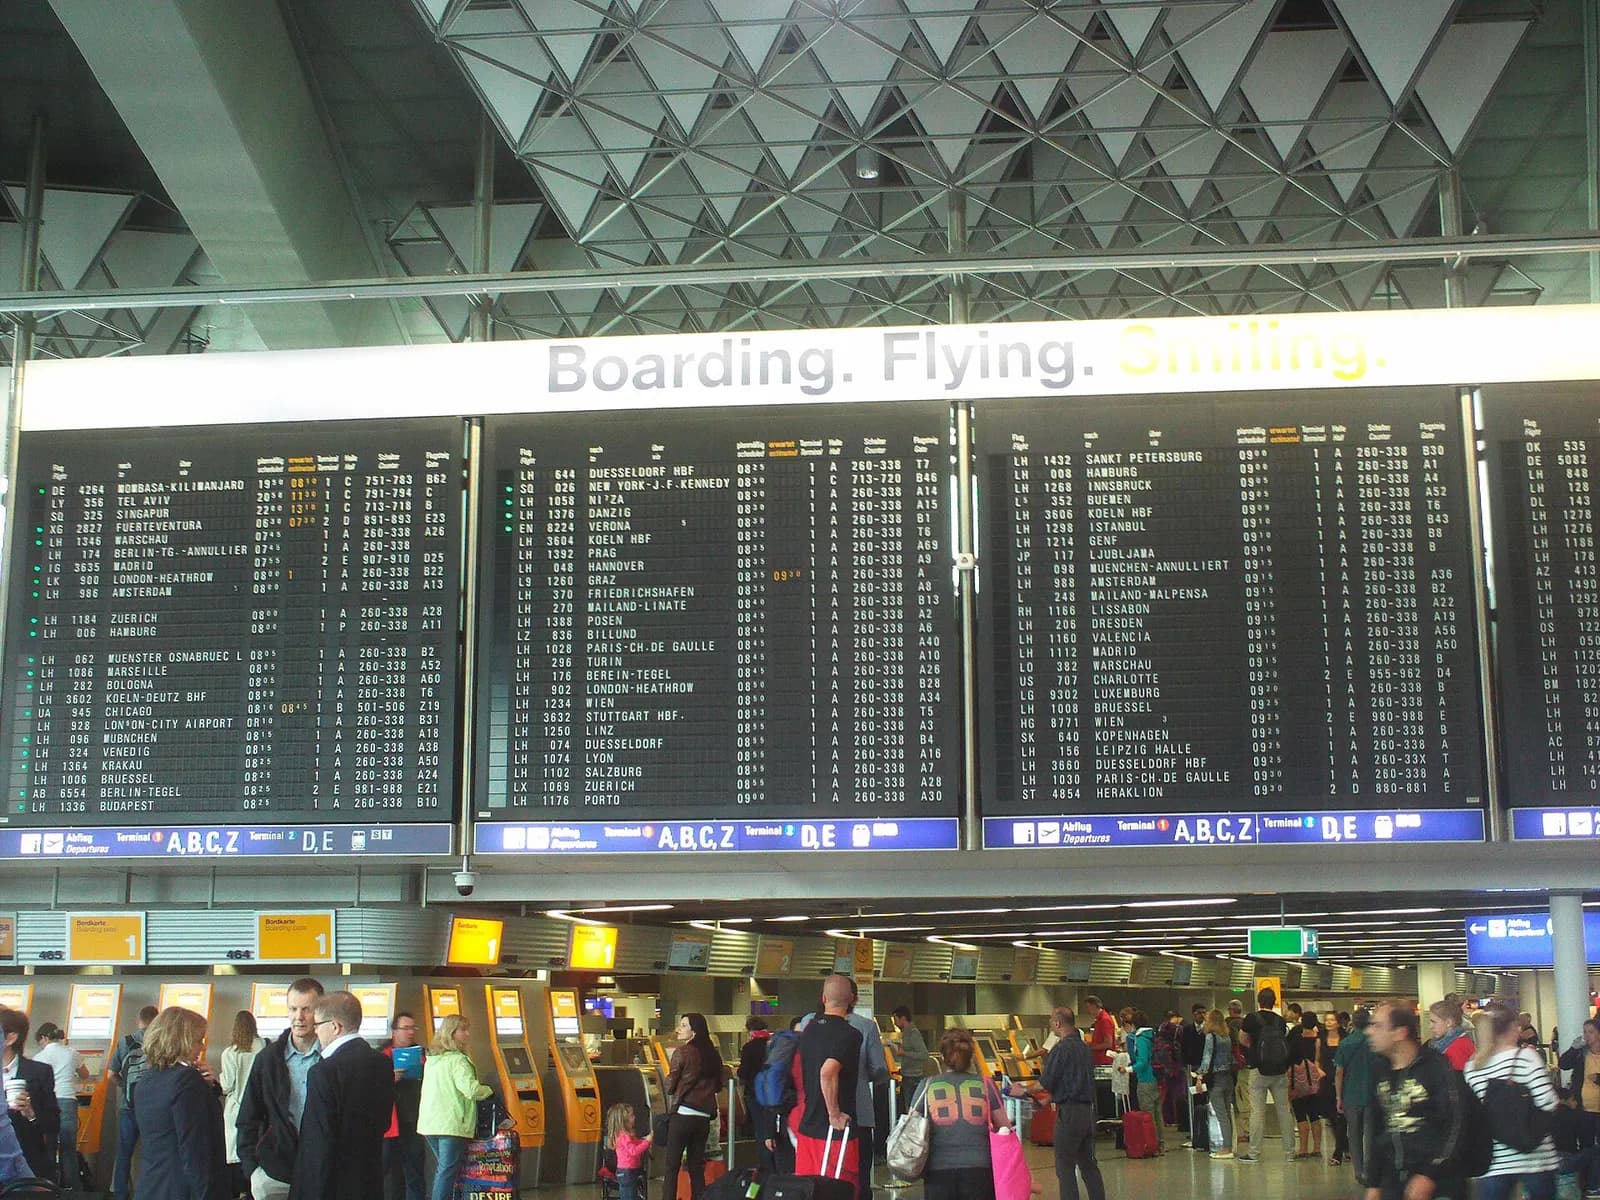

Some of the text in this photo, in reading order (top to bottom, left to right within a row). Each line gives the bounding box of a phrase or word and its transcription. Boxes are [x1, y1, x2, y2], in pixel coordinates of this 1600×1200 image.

[548, 320, 1386, 395] Boarding. Flying. Smiling.
[1526, 441, 1585, 452] OK 535
[1086, 452, 1202, 464] SANKT PETERSBURG
[1527, 456, 1541, 466] DE
[590, 466, 693, 478] DUESSELDORF HBF
[1087, 467, 1137, 477] HAMBURG
[1567, 468, 1588, 478] 848
[853, 474, 901, 484] 713-720
[589, 482, 610, 491] NEW
[1089, 480, 1151, 491] INNSBRUCK
[1530, 482, 1589, 493] LH 128
[366, 488, 411, 498] 791-794
[118, 496, 170, 506] TEL AVIV
[1570, 496, 1590, 505] 143
[117, 509, 169, 519] SINGAPUR
[589, 508, 630, 518] DANZIG
[1088, 507, 1152, 518] KOELN HBF
[1564, 509, 1591, 520] 1278
[116, 521, 201, 532] FUERTEVENTURA
[589, 521, 630, 531] VERONA
[1090, 521, 1145, 532] ISTANBUL
[1565, 523, 1592, 533] 1276
[115, 535, 168, 544] WARSCHAU
[589, 534, 651, 544] KOELN HBF
[1090, 536, 1117, 546] GENF
[589, 548, 616, 558] PRAG
[1575, 551, 1594, 561] 178
[114, 561, 153, 571] MADRID
[589, 561, 644, 571] HANNOVER
[1090, 560, 1228, 573] MUENCHEN-ANNULLIERT
[1536, 565, 1595, 576] AZ 413
[114, 573, 213, 584] LONDON-HEATHROW
[588, 575, 615, 585] GRAZ
[1091, 576, 1156, 587] AMSTERDAM
[1569, 579, 1596, 589] 1490
[113, 587, 171, 597] AMSTERDAM
[589, 587, 694, 598] FRIEDRICHSHAFEN
[1091, 589, 1207, 600] MAILAND-MALPENSA
[588, 600, 686, 612] MAILAND-LINATE
[1092, 604, 1149, 615] LISSABON
[111, 613, 157, 623] ZUERICH
[588, 616, 622, 625] POSEN
[1092, 618, 1142, 628] DRESDEN
[110, 626, 156, 636] HAMBURG
[588, 629, 636, 639] BILLUND
[1092, 632, 1150, 642] VALENCIA
[673, 641, 714, 651] GAULLE
[1093, 646, 1136, 656] MADRID
[108, 653, 161, 663] MUENSTER
[169, 651, 228, 662] OSNABRUEC
[588, 657, 622, 666] TURIN
[1093, 660, 1151, 670] WARSCHAU
[108, 666, 167, 676] MARSEILLE
[1370, 668, 1420, 679] 955-962
[1094, 674, 1158, 685] CHARLOTTE
[107, 680, 153, 690] BOLOGNA
[587, 683, 693, 694] LONDON-HEATHROW
[106, 692, 206, 703] KOELN-DEUTZ BHF
[1095, 688, 1159, 699] LUXEMBURG
[358, 702, 405, 712] 501-506
[586, 698, 614, 708] WIEN
[1095, 702, 1151, 713] BRUESSEL
[106, 707, 151, 716] CHICAGO
[586, 711, 649, 721] STUTTGART
[186, 718, 232, 728] AIRPORT
[1095, 716, 1123, 727] WIEN
[587, 725, 613, 735] LINZ
[1096, 730, 1168, 741] KOPENHAGEN
[586, 739, 662, 749] DUESSELDORF
[103, 747, 149, 756] VENEDIG
[1096, 744, 1190, 755] LEIPZIG HALLE
[586, 753, 613, 763] LYON
[102, 760, 142, 770] KRAKAU
[1096, 758, 1206, 769] DUESSELDORF HBF
[586, 767, 641, 777] SALZBURG
[1186, 771, 1229, 782] GAULLE
[102, 774, 154, 784] BRUESSEL
[585, 781, 634, 791] ZUERICH
[101, 787, 180, 797] BERLIN-TEGEL
[1097, 787, 1162, 798] HERAKLION
[585, 795, 619, 805] PORTO
[100, 801, 152, 811] BUDAPEST
[1063, 821, 1092, 833] Abflug
[1118, 820, 1155, 830] Terminal
[1174, 818, 1252, 843] A,B,C,Z
[1264, 818, 1302, 828] Terminal
[1322, 816, 1357, 841] D,E
[658, 825, 734, 850] A,B,C,Z
[801, 824, 835, 849] D,E
[1063, 834, 1111, 845] Departures
[117, 832, 150, 841] Terminal
[167, 831, 239, 854] A,B,C,Z
[250, 831, 284, 840] Terminal
[303, 831, 333, 853] D,E
[125, 935, 136, 957] 1
[314, 933, 326, 955] 1
[488, 938, 497, 961] 1
[604, 944, 613, 965] 1
[39, 950, 63, 960] 465
[780, 955, 791, 972] 2
[928, 1080, 988, 1126] 86
